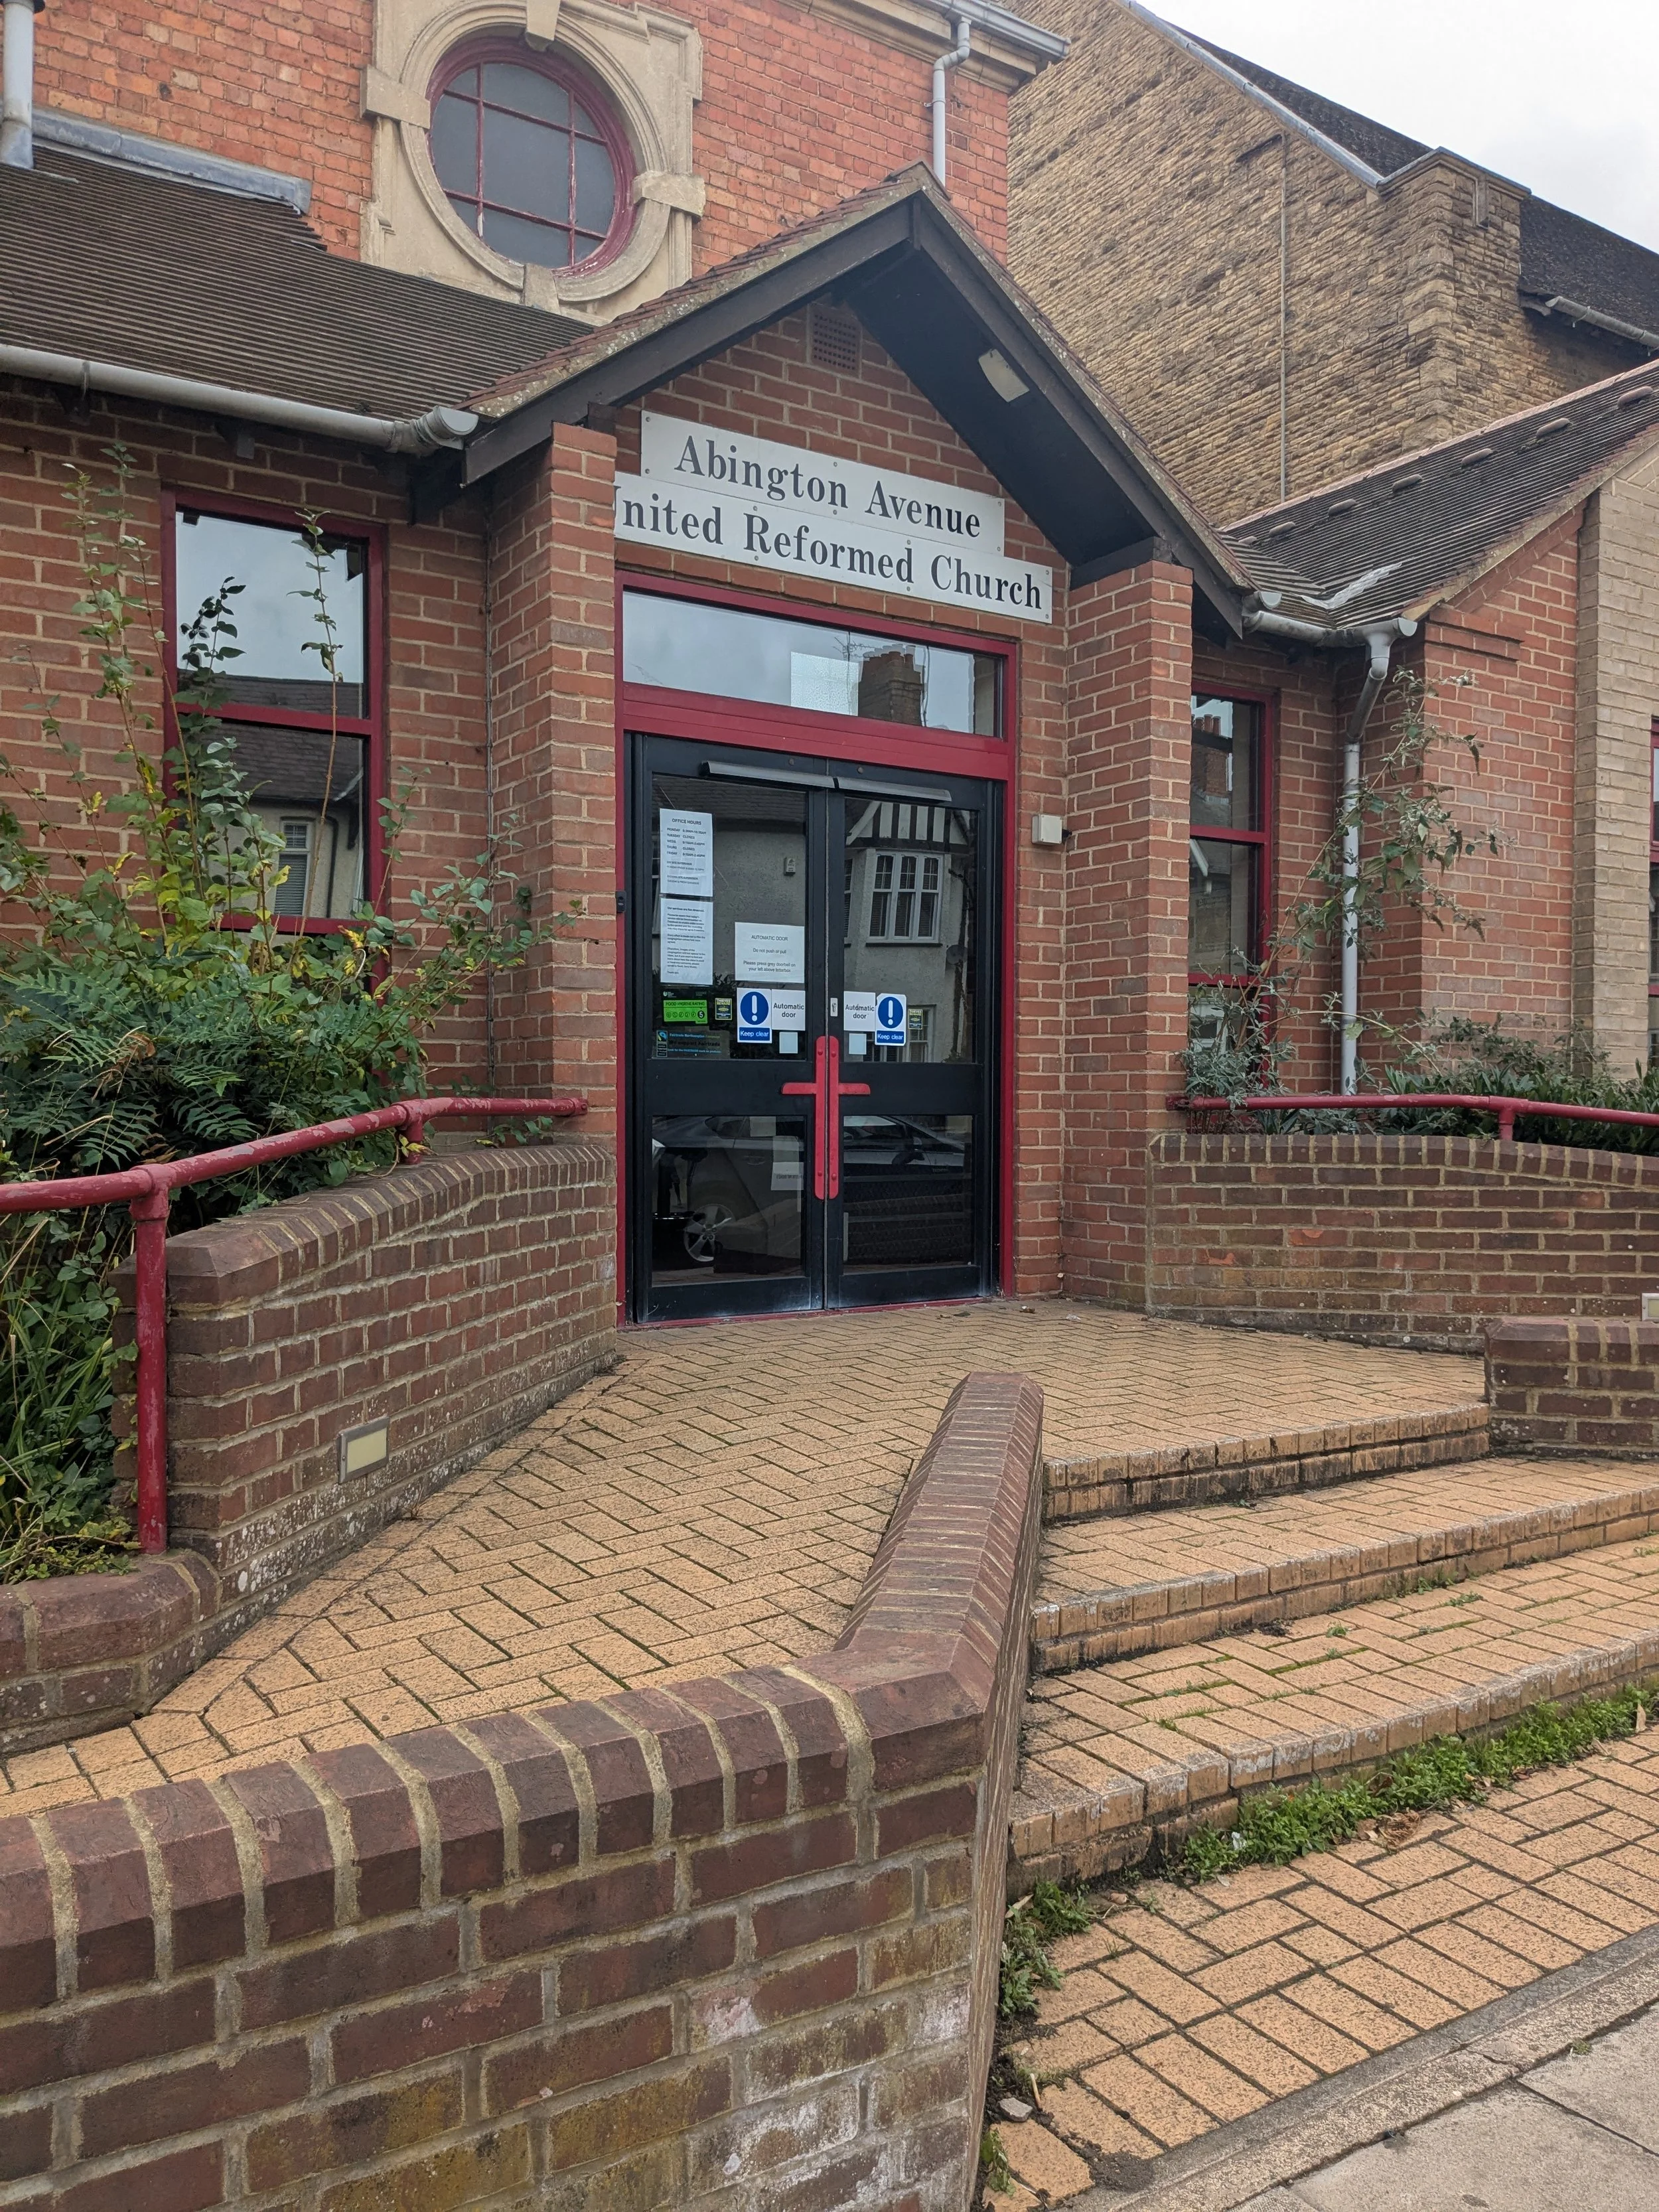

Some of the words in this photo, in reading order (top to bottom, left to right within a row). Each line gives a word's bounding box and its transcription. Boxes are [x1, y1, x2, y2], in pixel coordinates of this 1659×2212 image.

[674, 435, 849, 509] Abington
[864, 480, 980, 538] Avenue
[743, 512, 914, 584] Reformed
[930, 554, 1042, 610] Church
